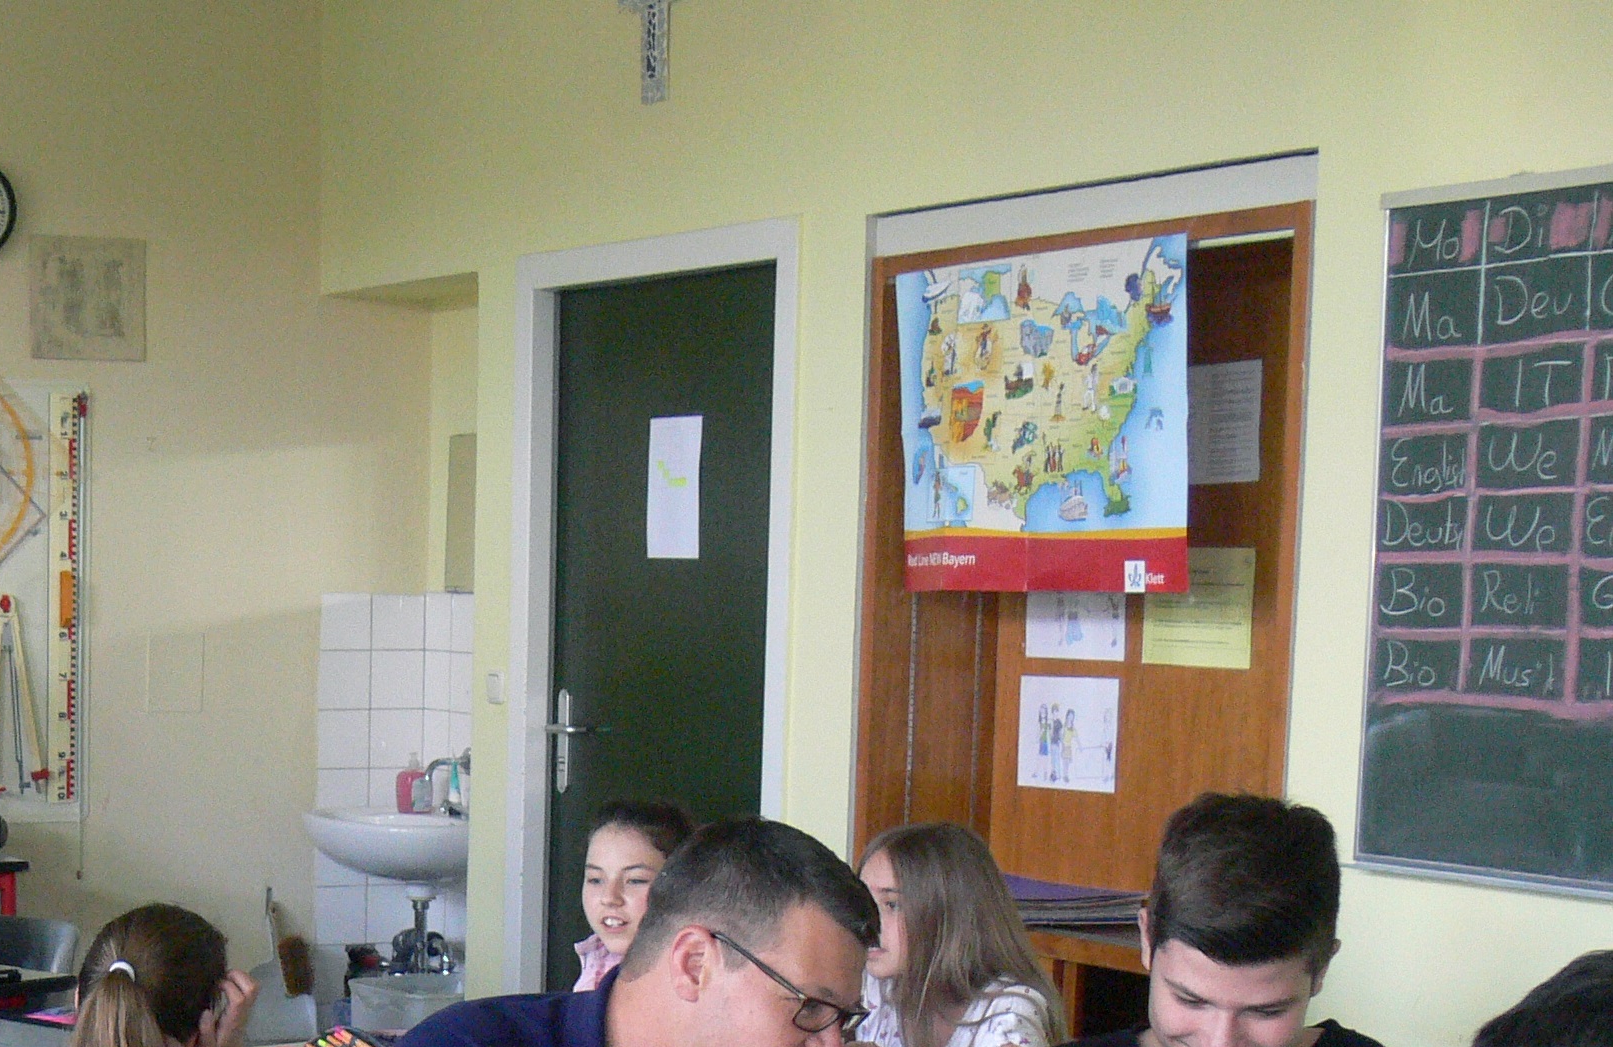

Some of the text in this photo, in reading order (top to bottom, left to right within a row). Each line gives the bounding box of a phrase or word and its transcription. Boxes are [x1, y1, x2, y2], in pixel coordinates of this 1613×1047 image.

[1407, 205, 1549, 270] Mo Di
[1402, 290, 1463, 342] Ma
[1397, 363, 1454, 417] Ma
[1488, 432, 1558, 480] We
[942, 551, 976, 569] Bayern
[1145, 571, 1165, 585] Klett
[1379, 566, 1446, 617] Bio
[1480, 570, 1540, 615] Reli
[1382, 640, 1436, 687] Bio
